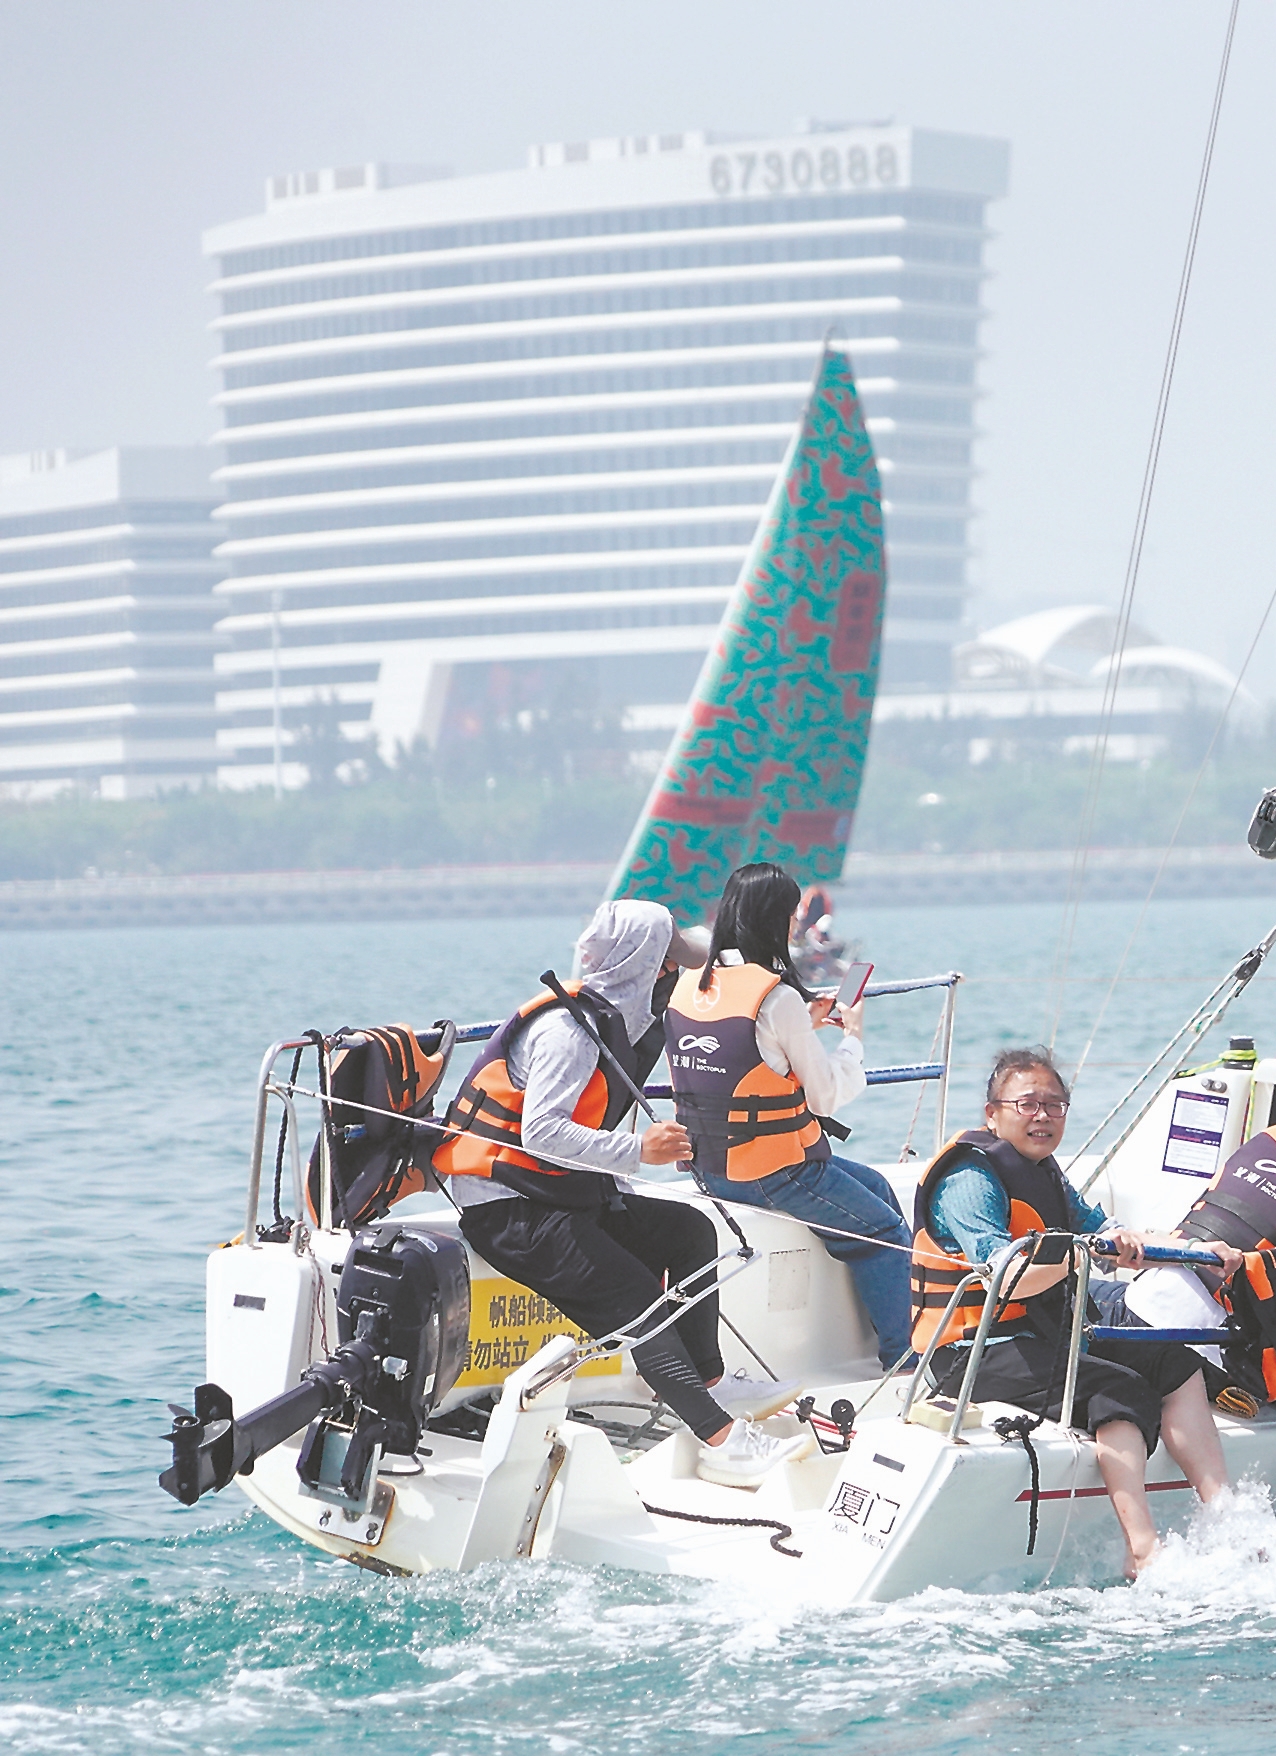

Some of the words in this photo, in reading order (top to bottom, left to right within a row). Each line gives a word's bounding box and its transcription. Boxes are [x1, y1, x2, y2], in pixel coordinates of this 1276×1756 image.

[709, 145, 898, 194] 6730888
[489, 1294, 568, 1328] 帆船倾斜
[828, 1481, 900, 1534] 厦门
[861, 1532, 886, 1550] MEN
